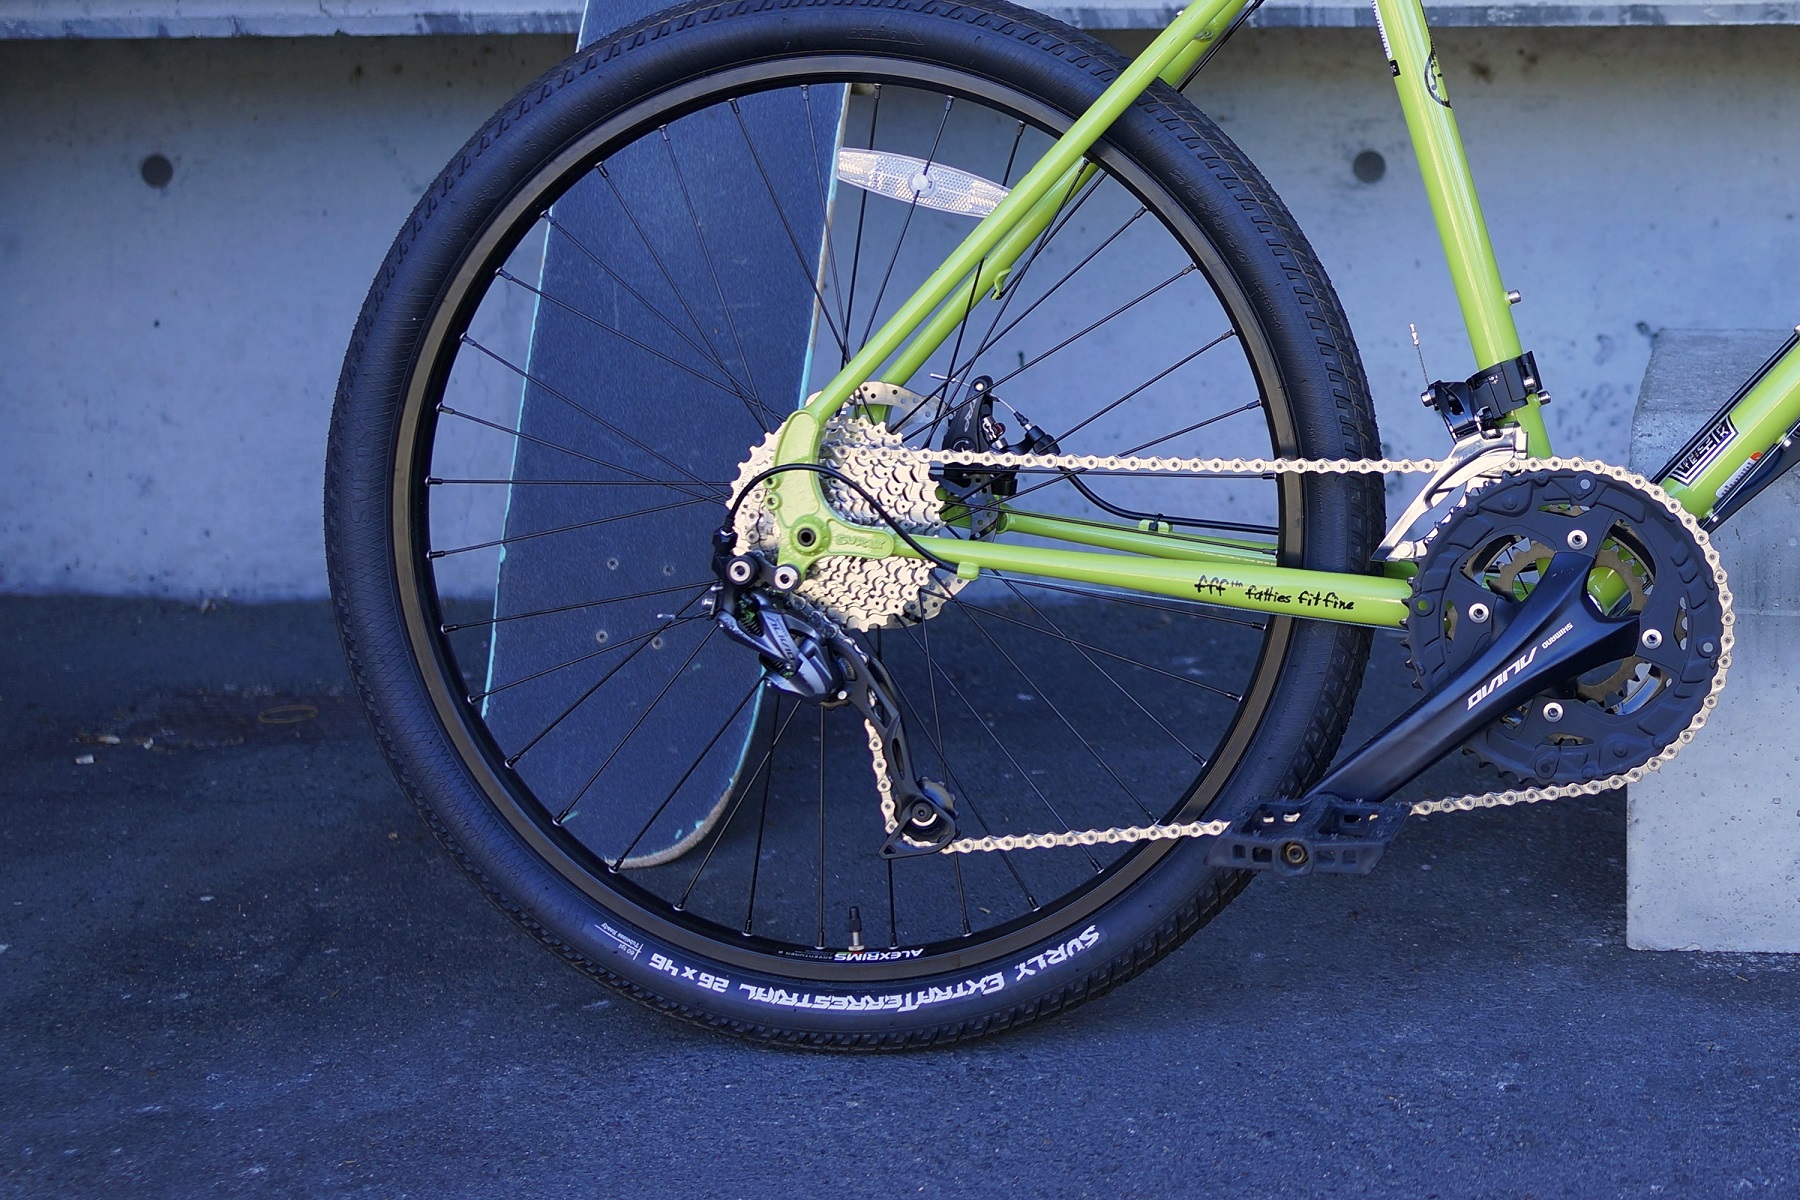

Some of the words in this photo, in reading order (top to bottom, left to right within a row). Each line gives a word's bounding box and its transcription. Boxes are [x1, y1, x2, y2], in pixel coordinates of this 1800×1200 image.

[1245, 585, 1291, 604] fatties
[1542, 622, 1574, 650] SHIMANO
[834, 948, 924, 962] ALEXRIMS
[1016, 924, 1100, 982] SURLY
[649, 953, 679, 976] 46
[697, 973, 730, 992] 26
